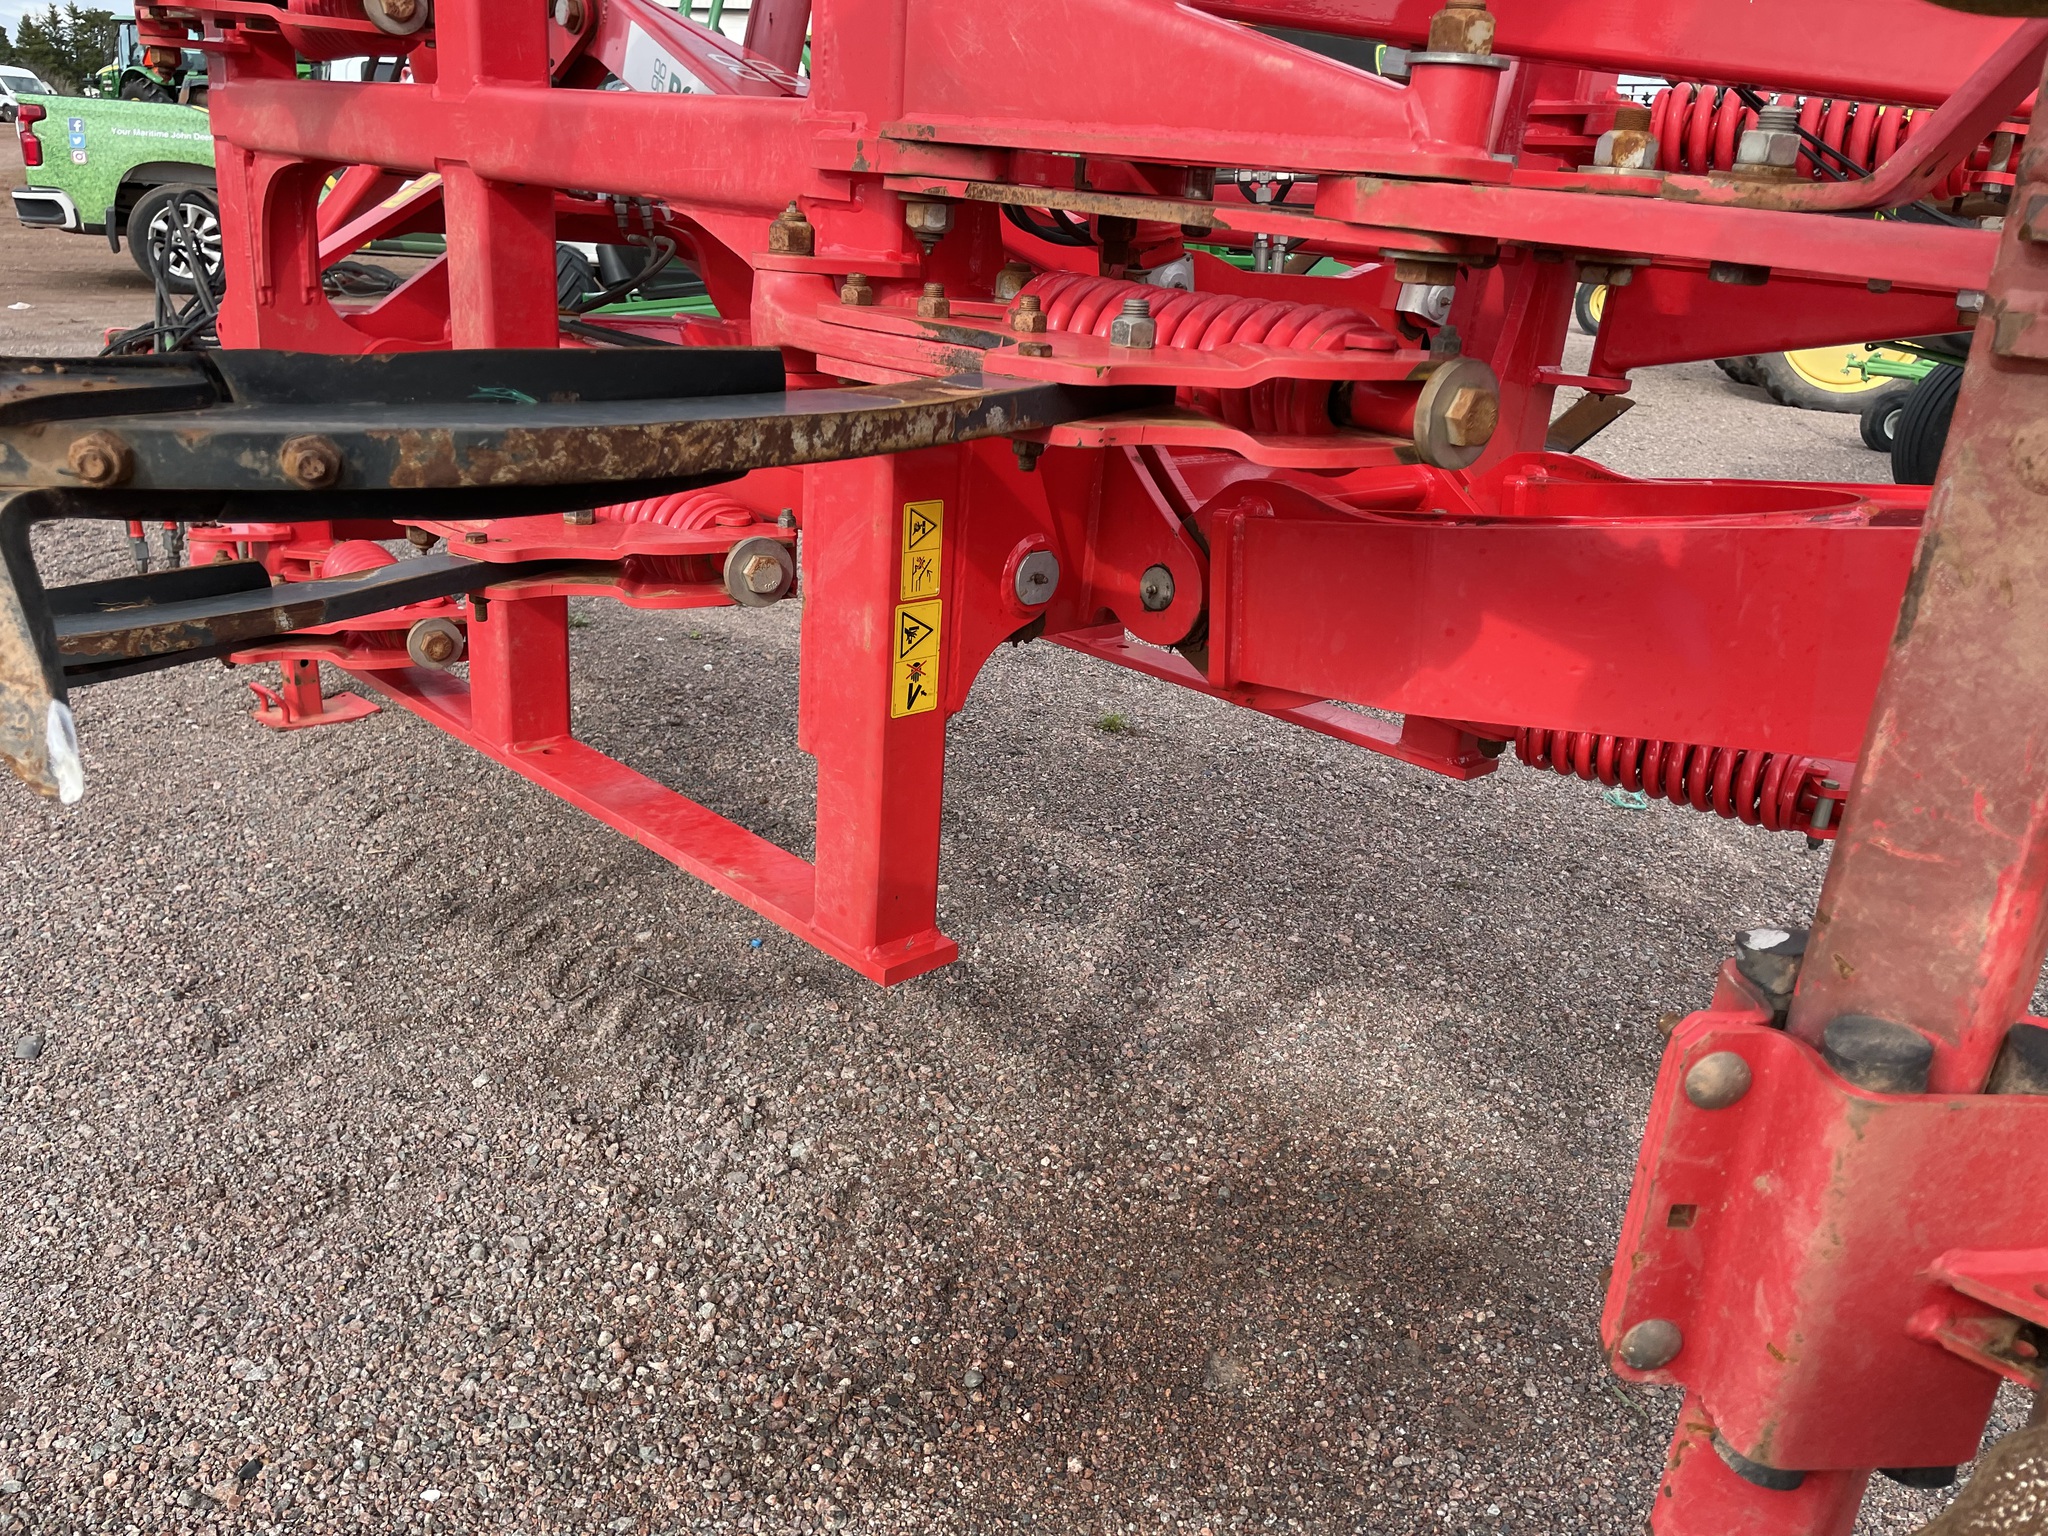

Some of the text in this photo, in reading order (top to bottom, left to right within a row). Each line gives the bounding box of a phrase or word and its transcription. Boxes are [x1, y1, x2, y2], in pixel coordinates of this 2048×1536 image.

[111, 127, 131, 135] Your
[133, 128, 169, 138] Maritime
[170, 131, 192, 139] John
